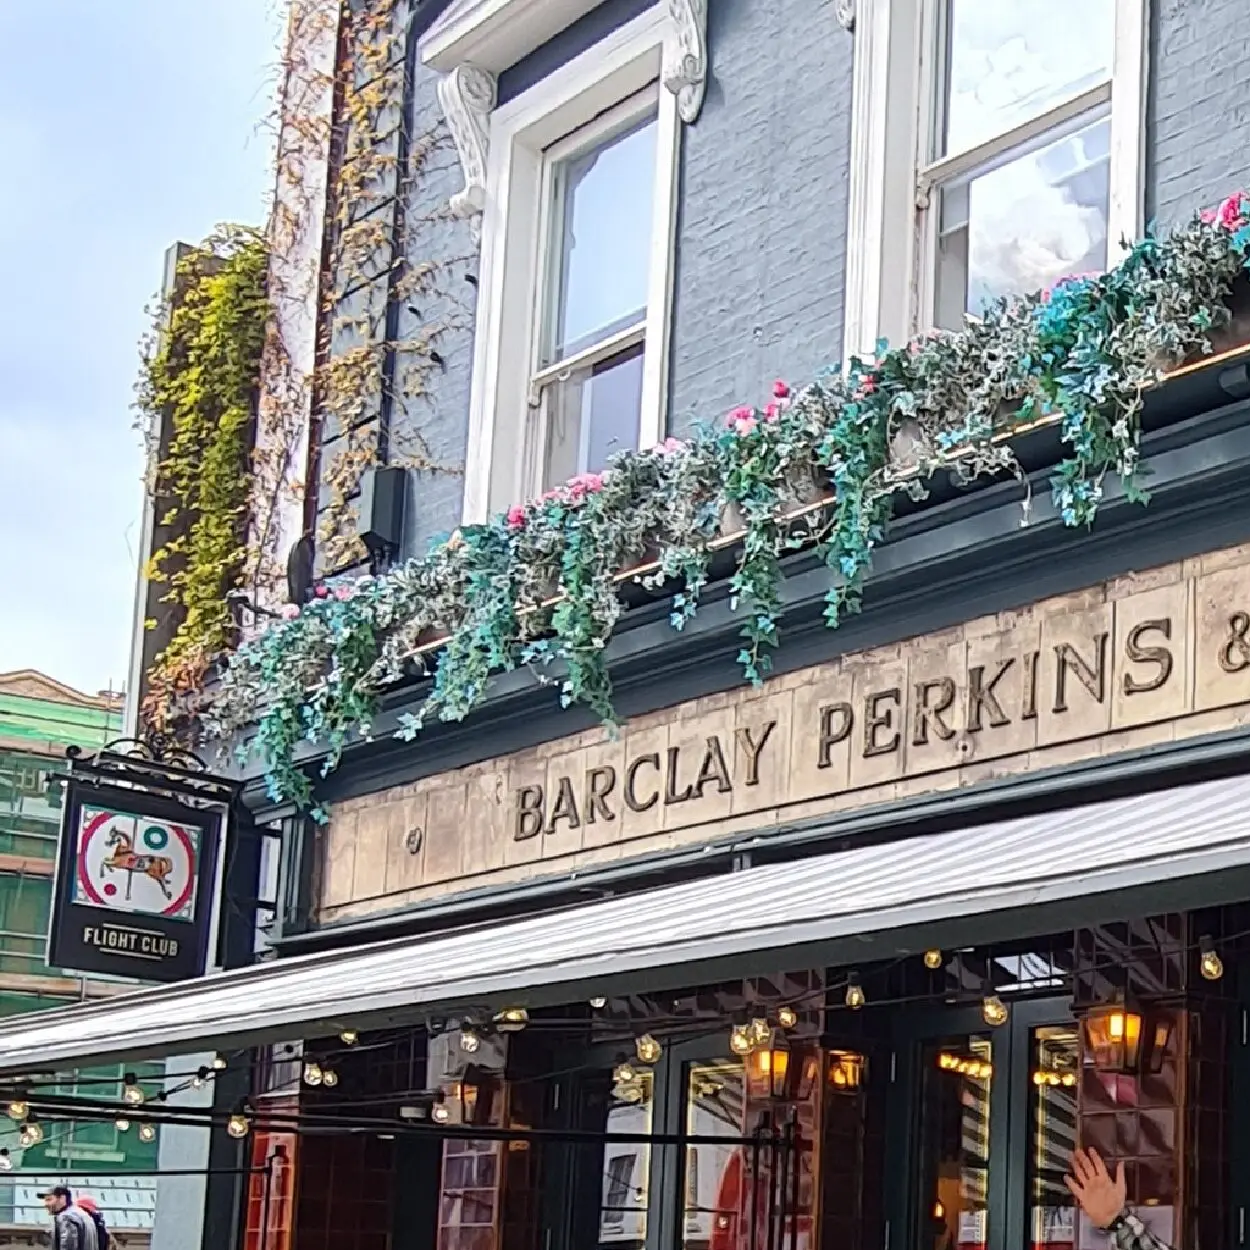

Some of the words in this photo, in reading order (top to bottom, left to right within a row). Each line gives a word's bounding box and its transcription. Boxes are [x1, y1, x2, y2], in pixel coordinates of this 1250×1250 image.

[513, 719, 776, 842] BARCLAY
[816, 617, 1172, 769] PERKINS
[83, 927, 138, 950] FLIGHT
[141, 936, 178, 956] CLUB
